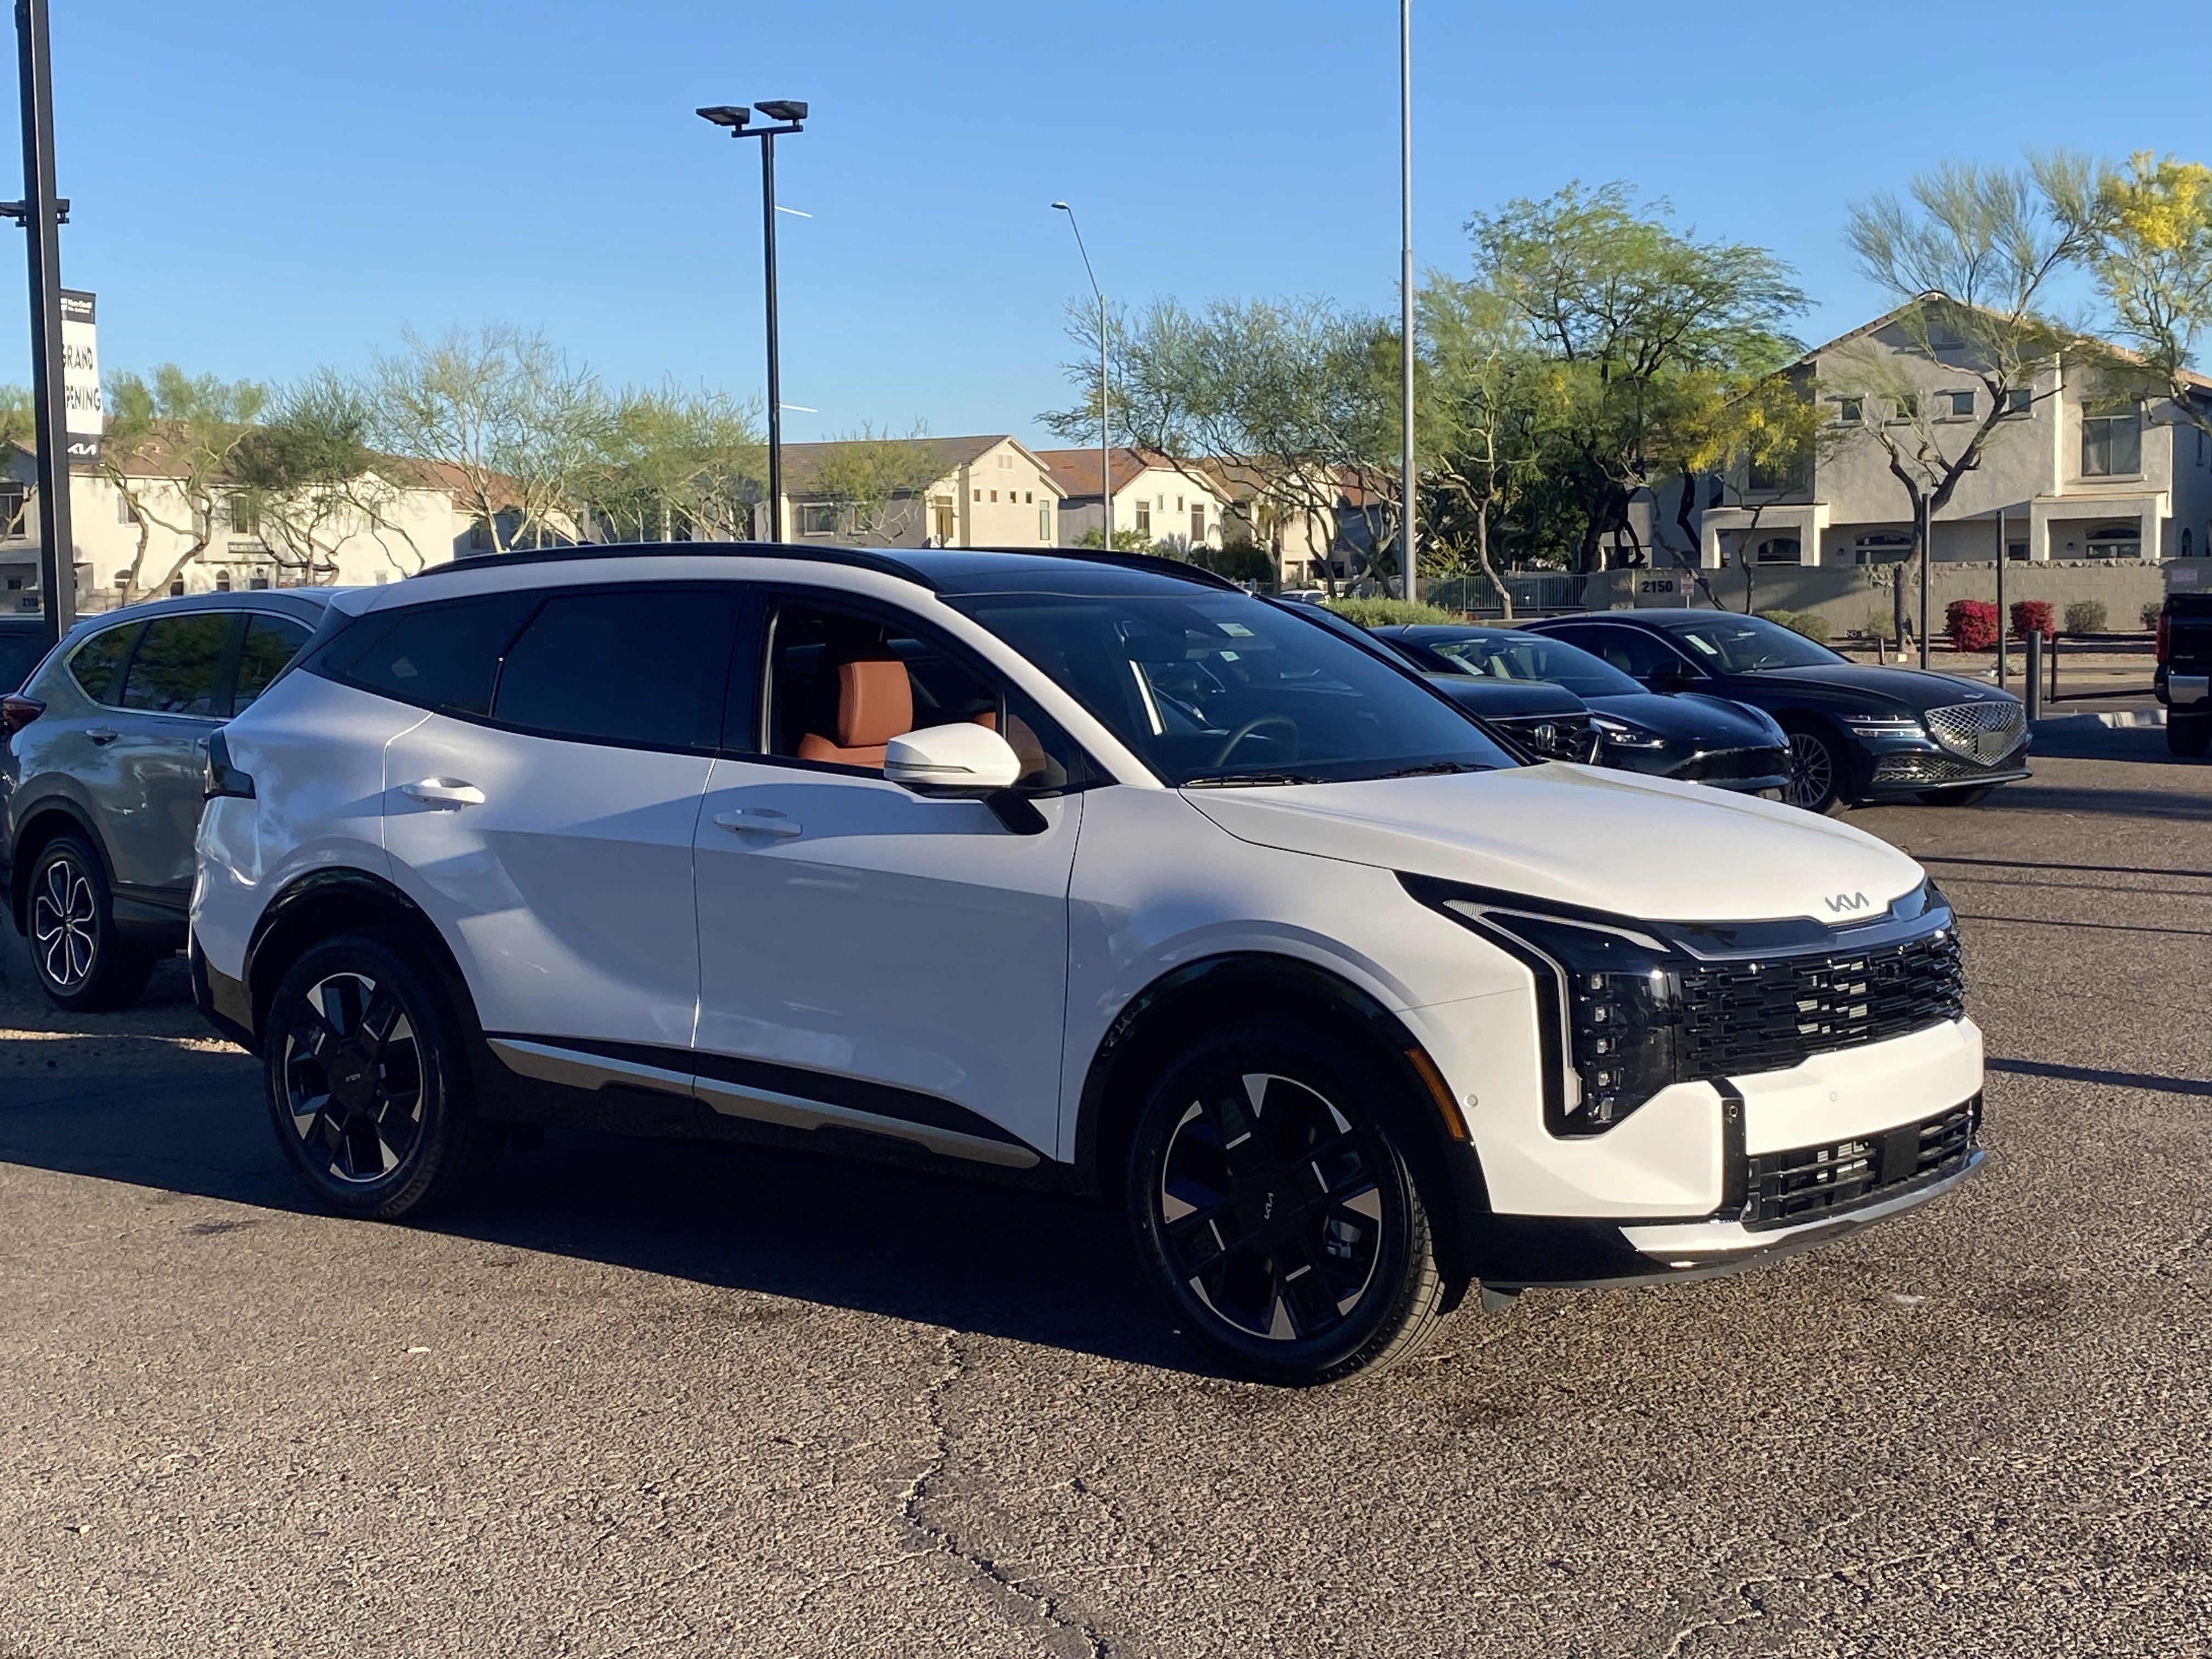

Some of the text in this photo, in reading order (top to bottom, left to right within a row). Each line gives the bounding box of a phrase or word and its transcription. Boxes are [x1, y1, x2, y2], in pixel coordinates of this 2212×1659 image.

[65, 386, 101, 411] PENING
[1641, 580, 1673, 593] 2150
[1825, 892, 1869, 912] KIA
